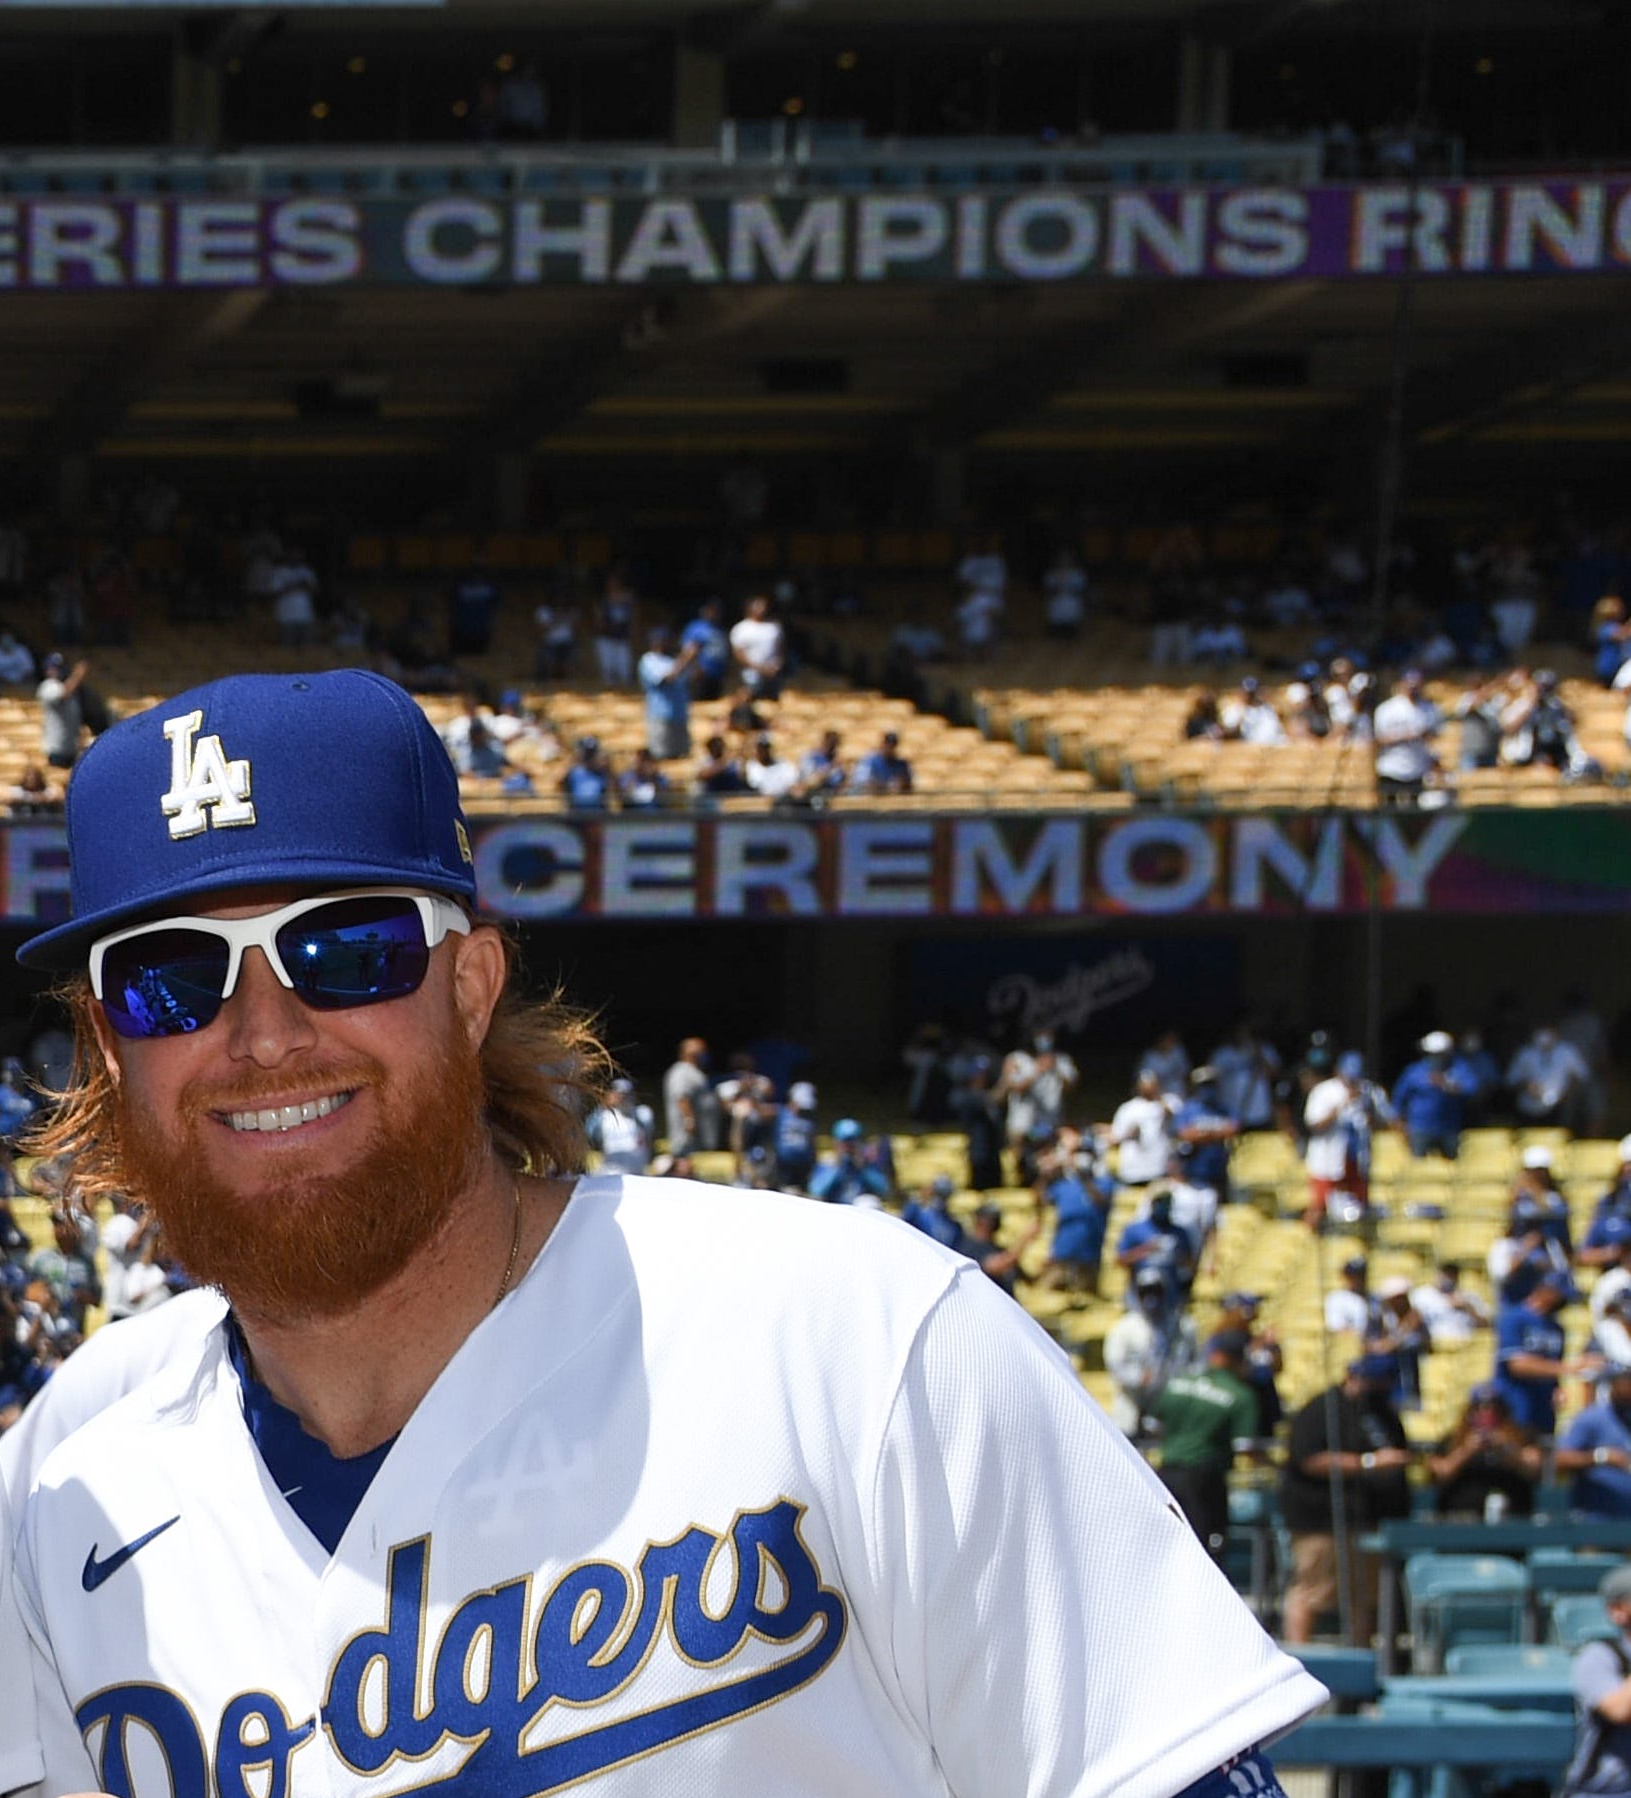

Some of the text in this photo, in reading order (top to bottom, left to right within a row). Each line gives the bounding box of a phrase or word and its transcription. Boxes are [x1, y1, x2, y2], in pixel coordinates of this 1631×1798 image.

[402, 192, 1309, 283] CHAMPIONS
[1353, 183, 1631, 273] RIN
[161, 709, 257, 841] LA
[475, 815, 1471, 918] CEREMONY
